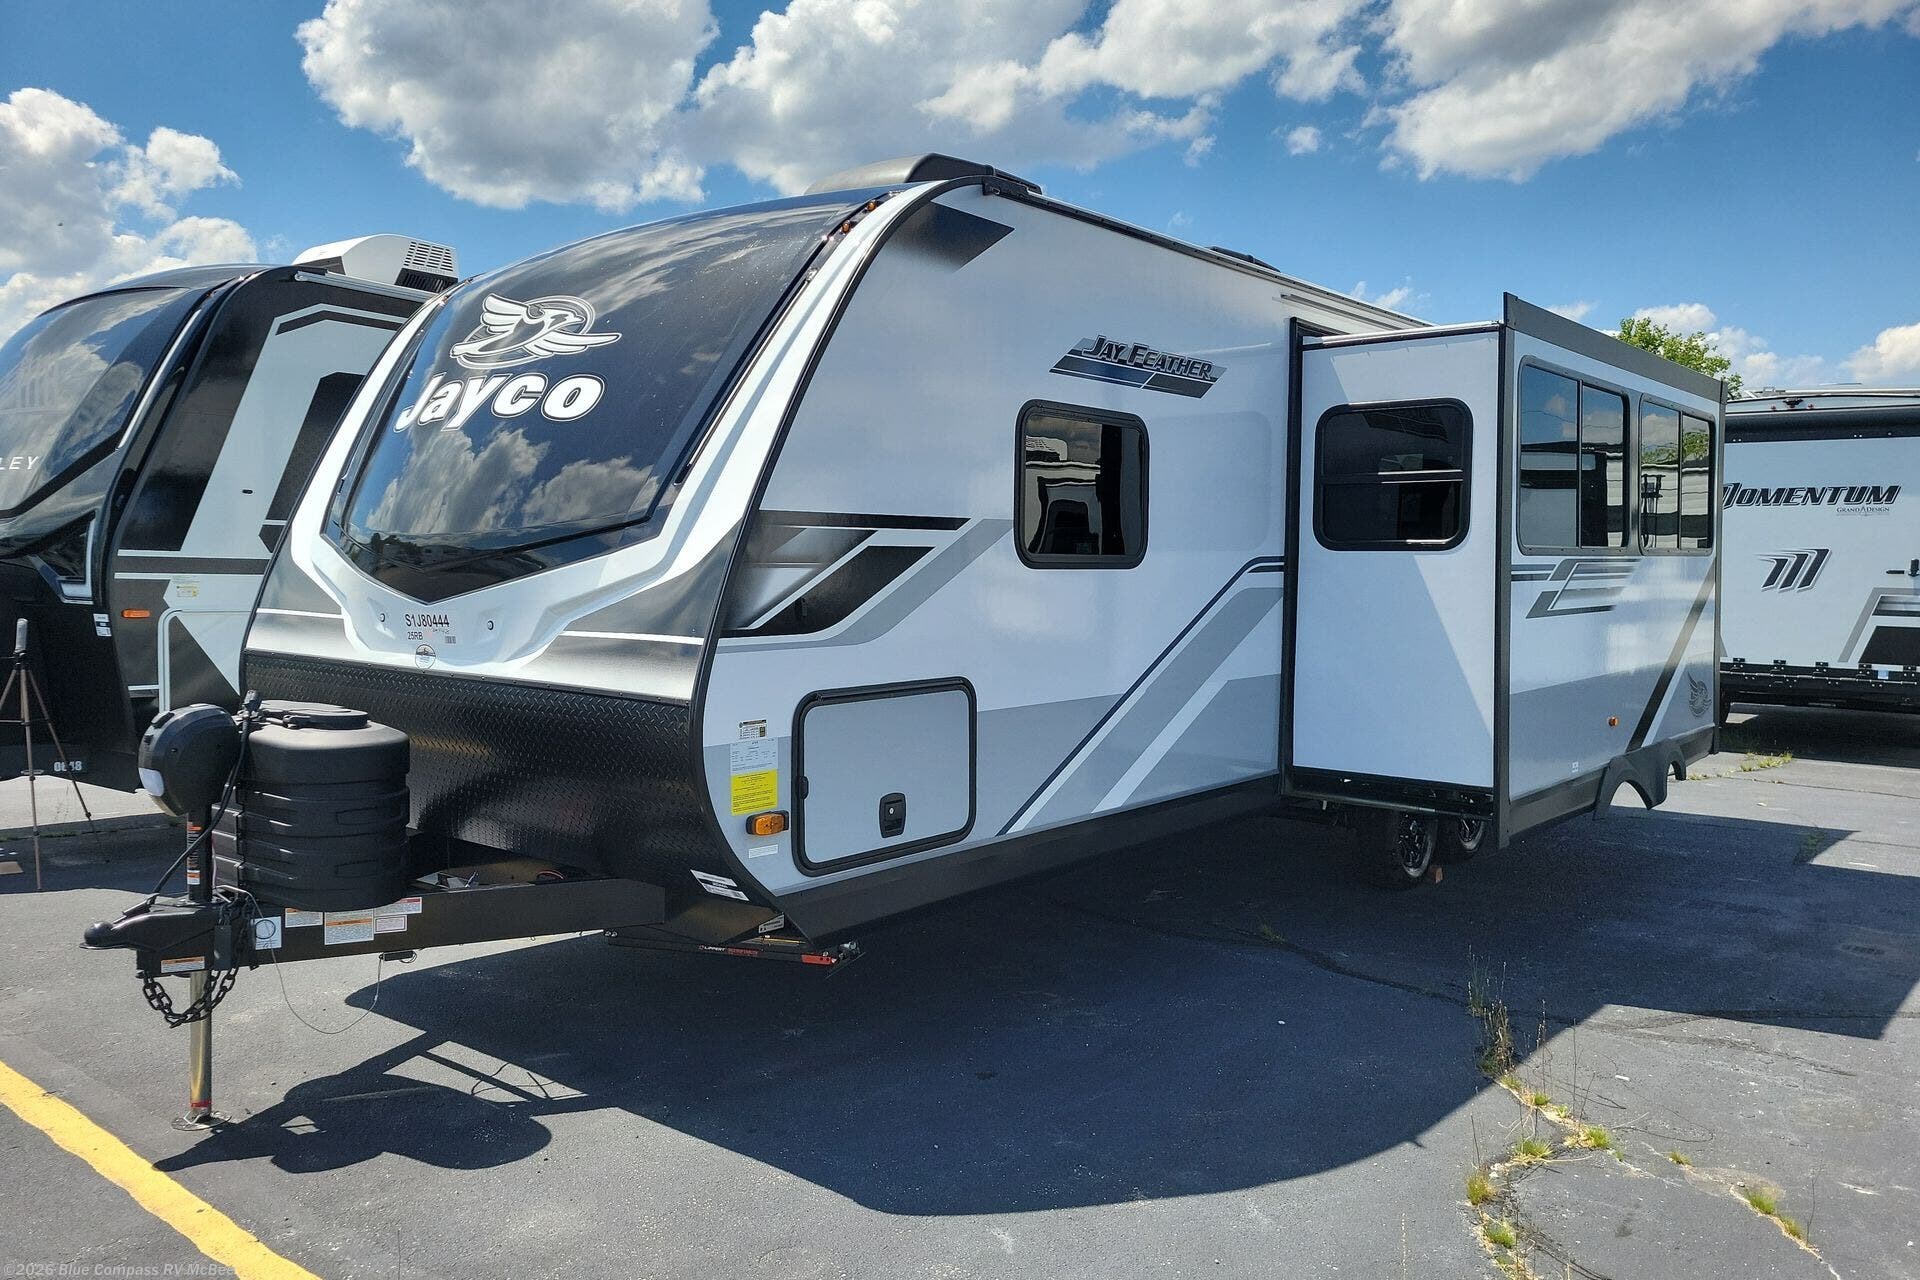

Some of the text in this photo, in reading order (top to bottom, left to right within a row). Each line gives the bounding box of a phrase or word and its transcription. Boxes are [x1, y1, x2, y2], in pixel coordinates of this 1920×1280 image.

[1082, 334, 1214, 380] JAY FEATHER
[393, 372, 605, 433] Jayco
[404, 613, 450, 627] S1J80444
[407, 631, 424, 640] 25RB
